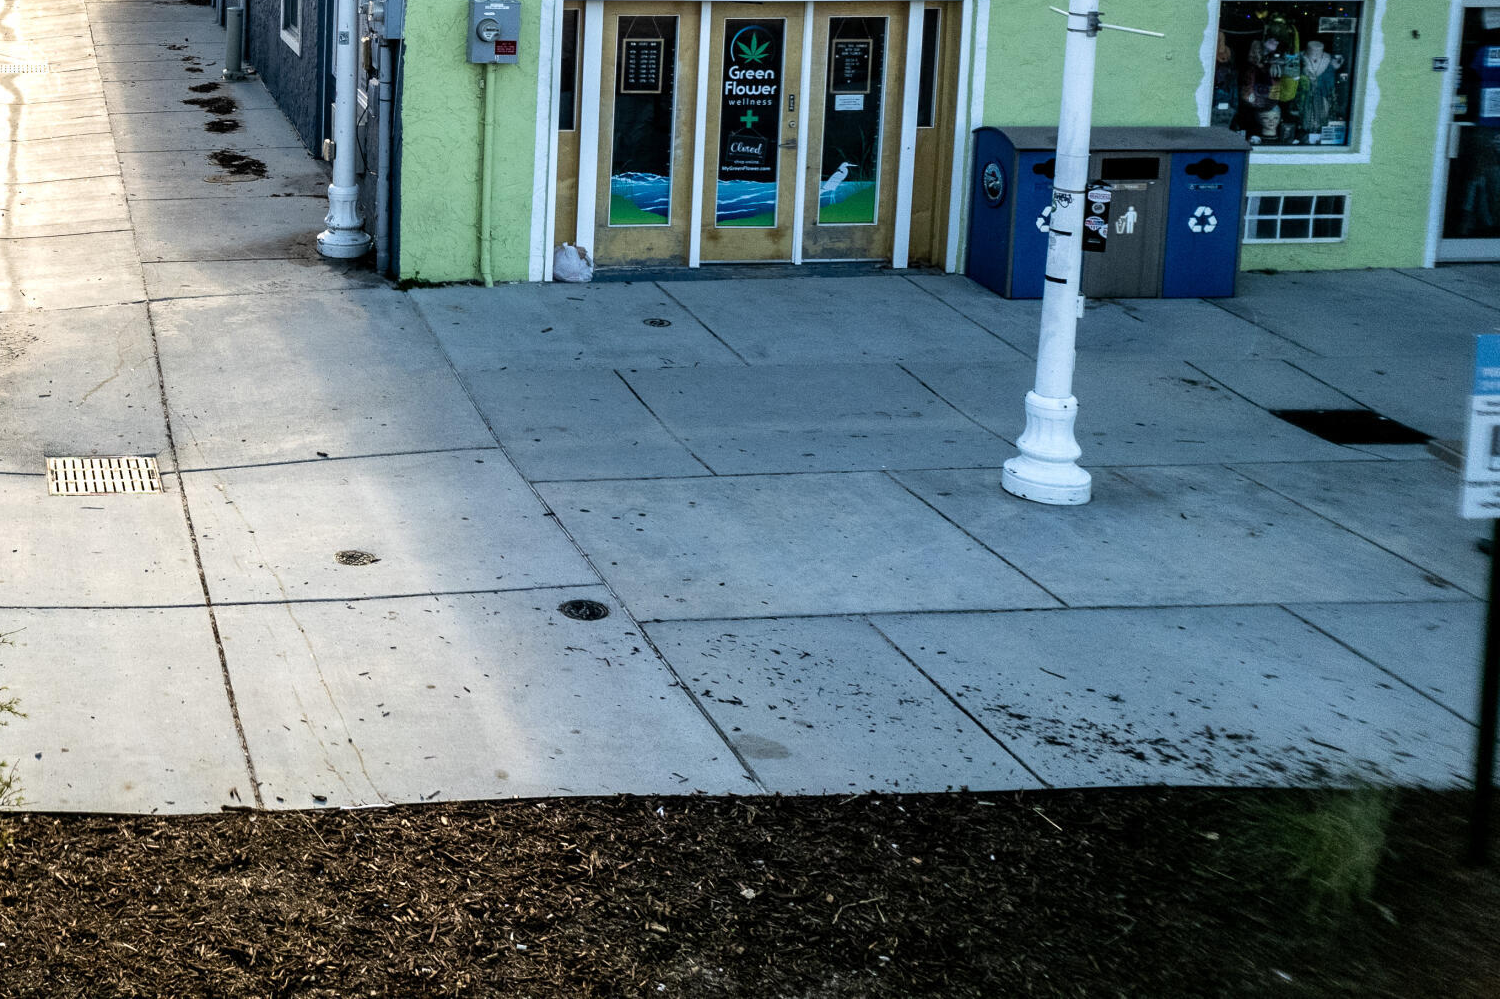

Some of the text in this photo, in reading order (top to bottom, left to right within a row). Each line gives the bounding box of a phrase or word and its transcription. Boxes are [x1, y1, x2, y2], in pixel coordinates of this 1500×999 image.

[728, 65, 775, 80] Green
[725, 80, 777, 95] Flower
[728, 98, 772, 106] wellness
[730, 141, 763, 155] Closed
